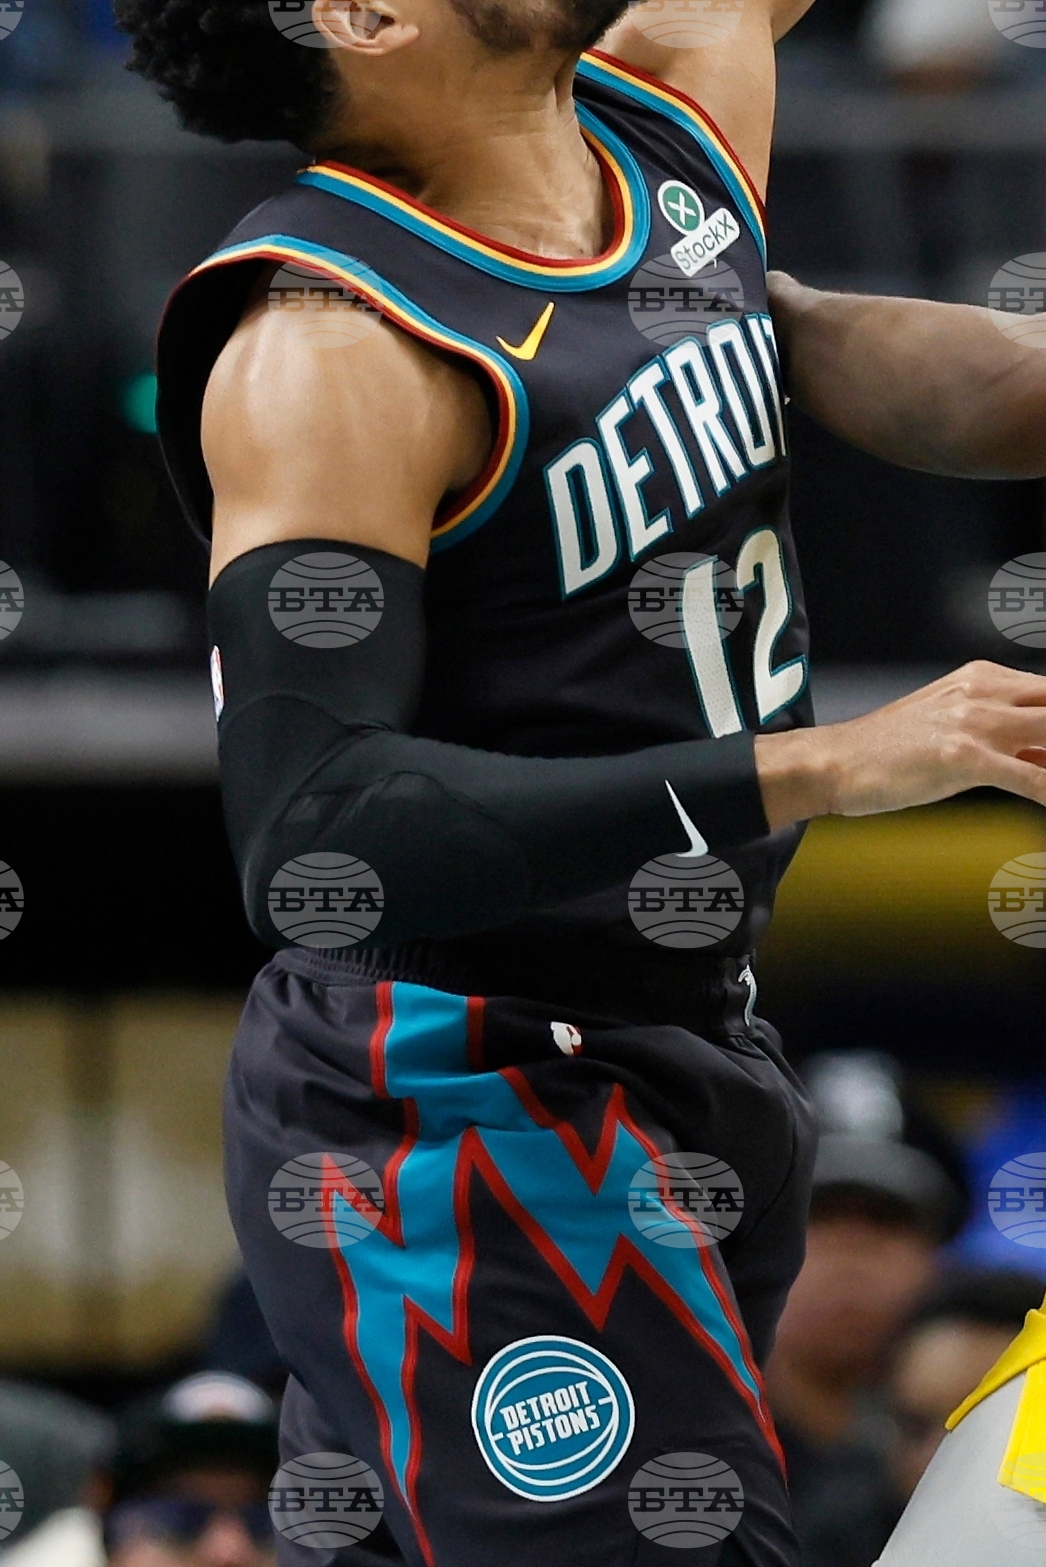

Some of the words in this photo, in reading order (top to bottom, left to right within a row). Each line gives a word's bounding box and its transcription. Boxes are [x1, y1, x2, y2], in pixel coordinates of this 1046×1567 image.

[680, 523, 808, 740] 12
[500, 1381, 590, 1430] DETROIT
[507, 1405, 600, 1455] PISTONS
